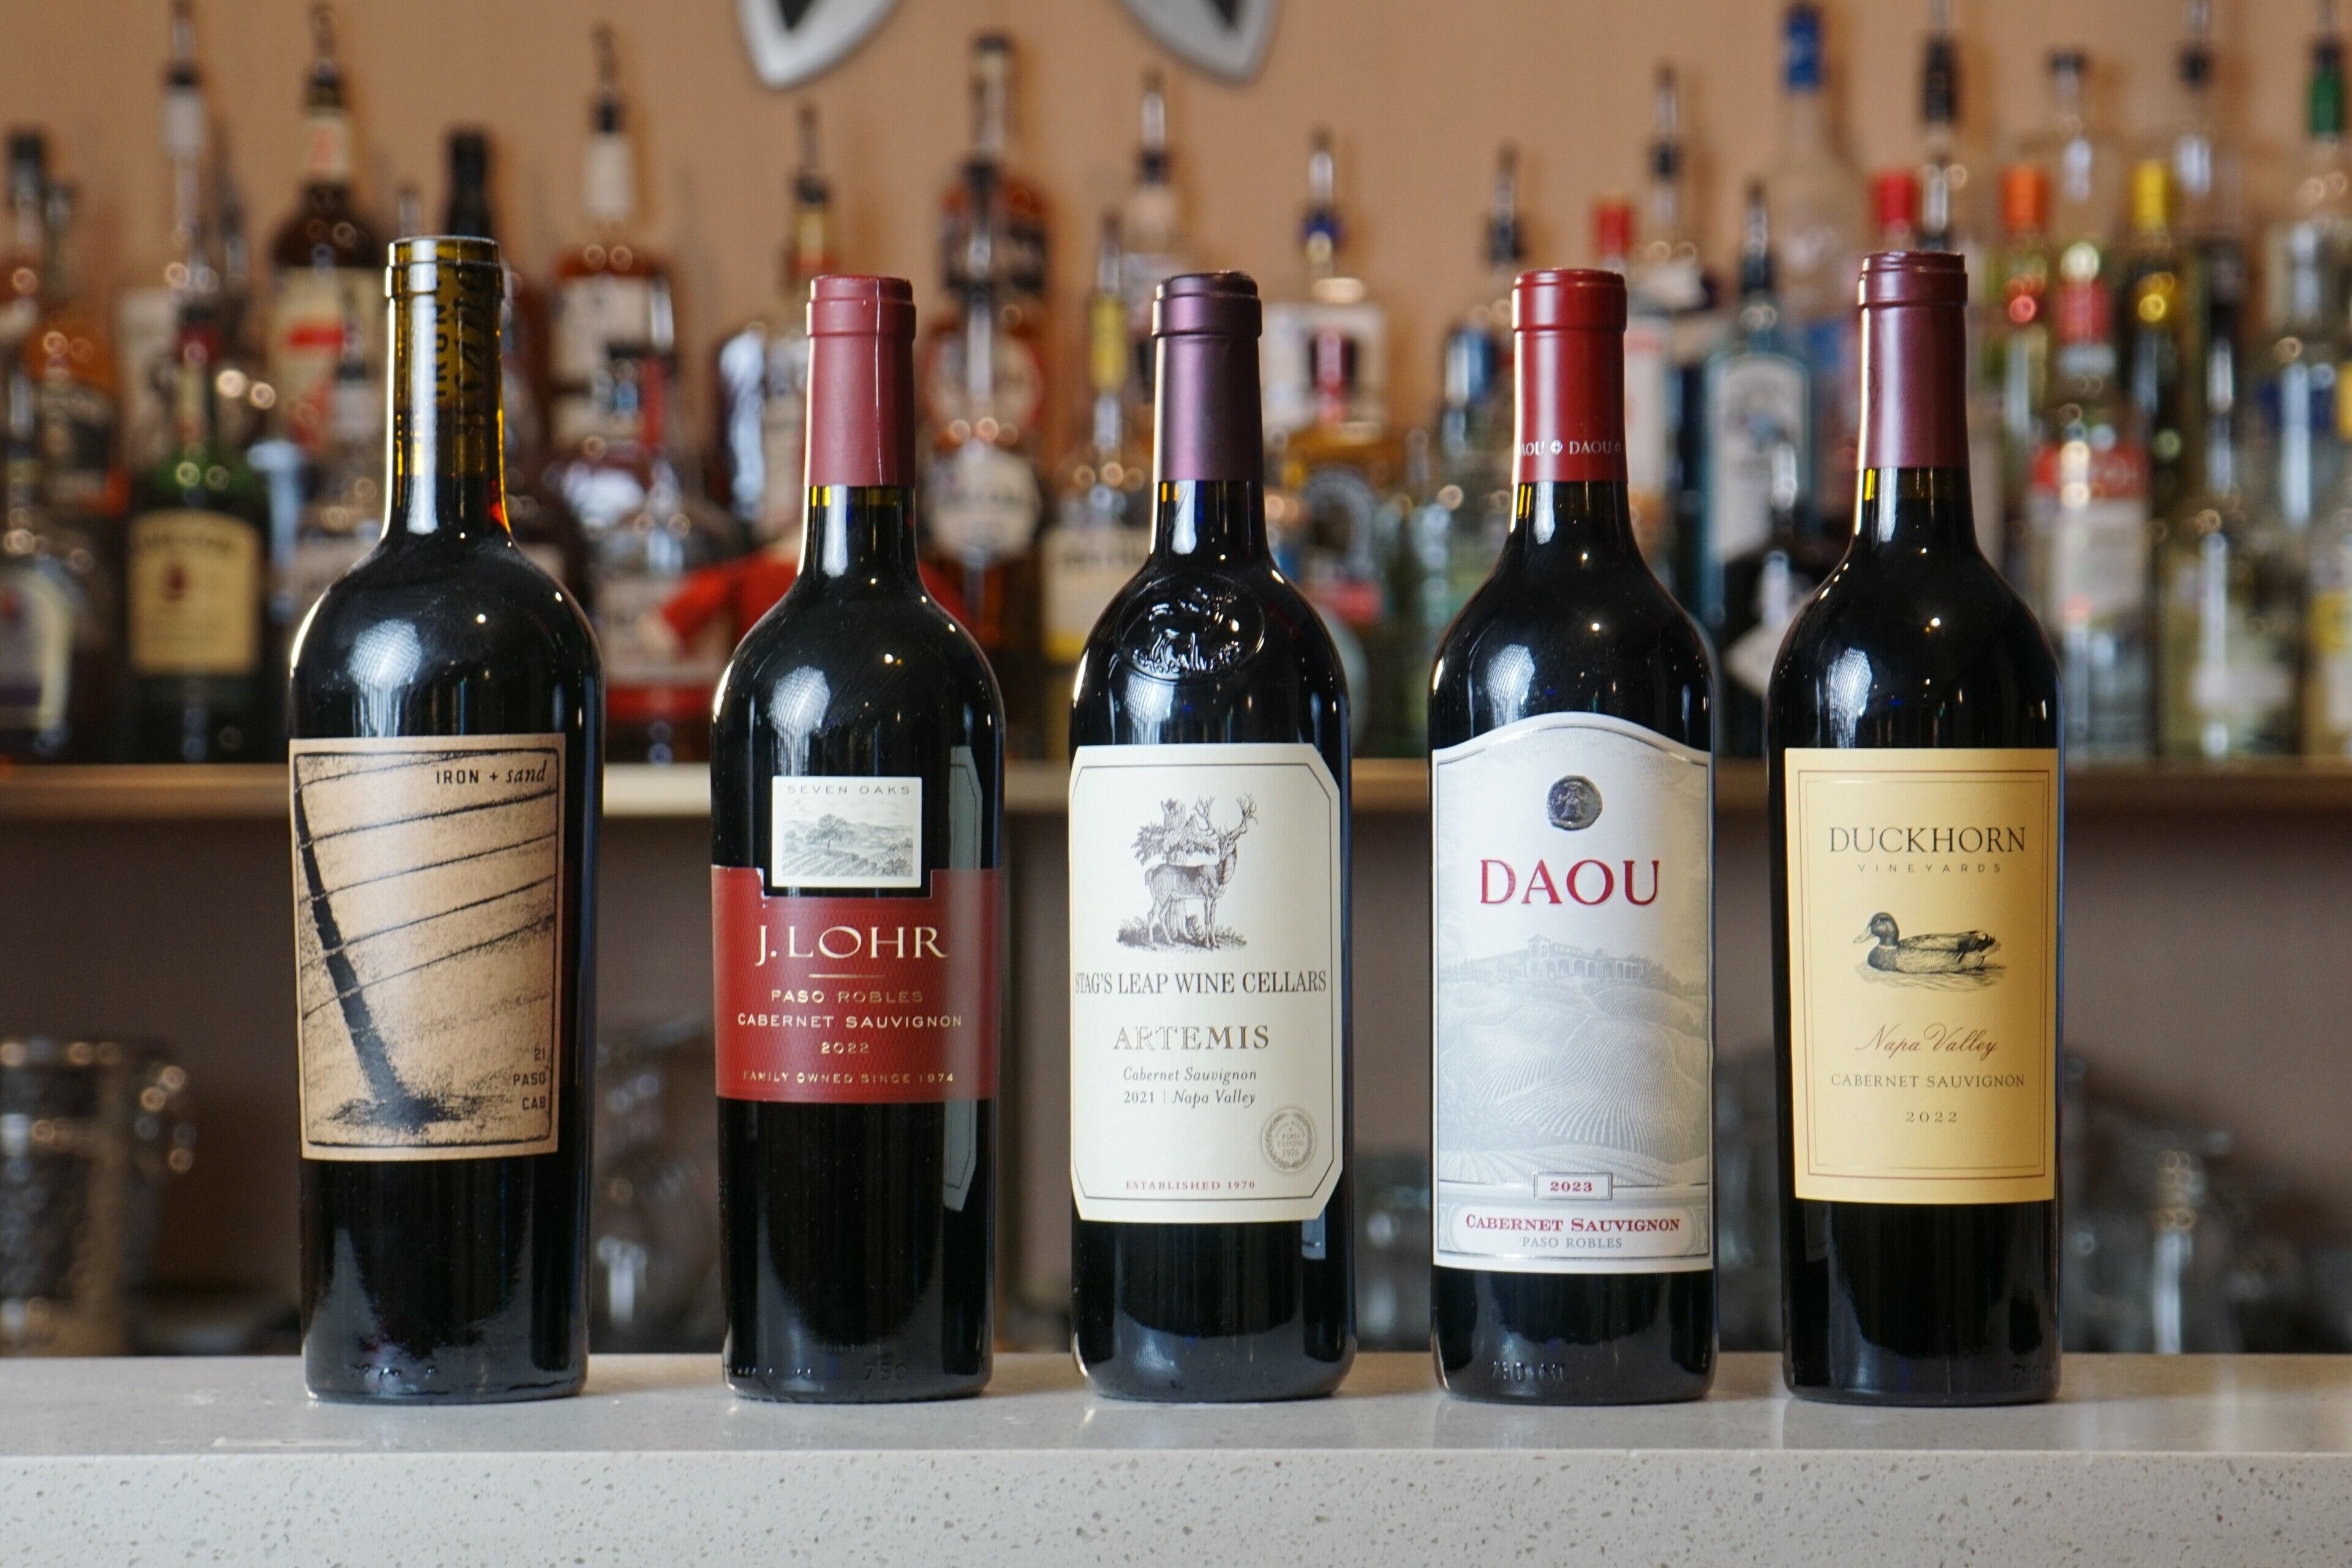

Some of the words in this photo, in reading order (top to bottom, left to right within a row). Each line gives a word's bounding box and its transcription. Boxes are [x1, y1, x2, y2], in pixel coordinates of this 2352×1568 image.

[1520, 442, 1545, 456] AOU
[1569, 441, 1611, 455] DAOU
[436, 769, 479, 784] IRON
[506, 760, 548, 783] sand
[787, 786, 848, 794] SEVEN
[859, 786, 910, 795] OAKS
[1829, 827, 2026, 853] DUCKHORN
[1858, 863, 2001, 873] VINEYARDS
[1480, 859, 1659, 906] DAOU
[1076, 972, 1113, 994] STAG'S
[1118, 973, 1169, 993] LEAP
[1175, 973, 1235, 993] WINE
[1242, 970, 1327, 993] CELLARS
[771, 990, 825, 1004] PASO
[838, 990, 924, 1003] ROBLES
[738, 1013, 835, 1028] CABERNET
[846, 1014, 962, 1029] SAUVIGNON
[1113, 1025, 1270, 1050] ARTEMIS
[1855, 1023, 1921, 1059] Napa
[1924, 1022, 1999, 1061] Valley
[821, 1042, 870, 1055] 2022
[513, 1072, 546, 1086] PASO
[742, 1072, 789, 1083] FAMILY
[797, 1072, 853, 1084] OWNED
[861, 1072, 911, 1084] SINCE
[919, 1072, 954, 1083] 1974
[1123, 1067, 1180, 1081] Cabernet
[1185, 1067, 1257, 1085] Sauvignon
[1831, 1074, 1920, 1088] CABERNET
[1926, 1075, 2025, 1088] SAUVIGNON
[522, 1096, 547, 1110] CAB
[1123, 1090, 1155, 1104] 2021
[1172, 1090, 1209, 1108] Napa
[1216, 1090, 1256, 1108] Valley
[1905, 1112, 1958, 1123] 2022
[1126, 1181, 1221, 1191] ESTABLISHED
[1227, 1181, 1256, 1190] 1970
[1550, 1182, 1593, 1192] 2023
[1466, 1214, 1564, 1231] CABERNET
[1570, 1218, 1680, 1232] SAUVIGNON
[1521, 1237, 1559, 1248] PASO
[1566, 1238, 1623, 1248] ROBLES
